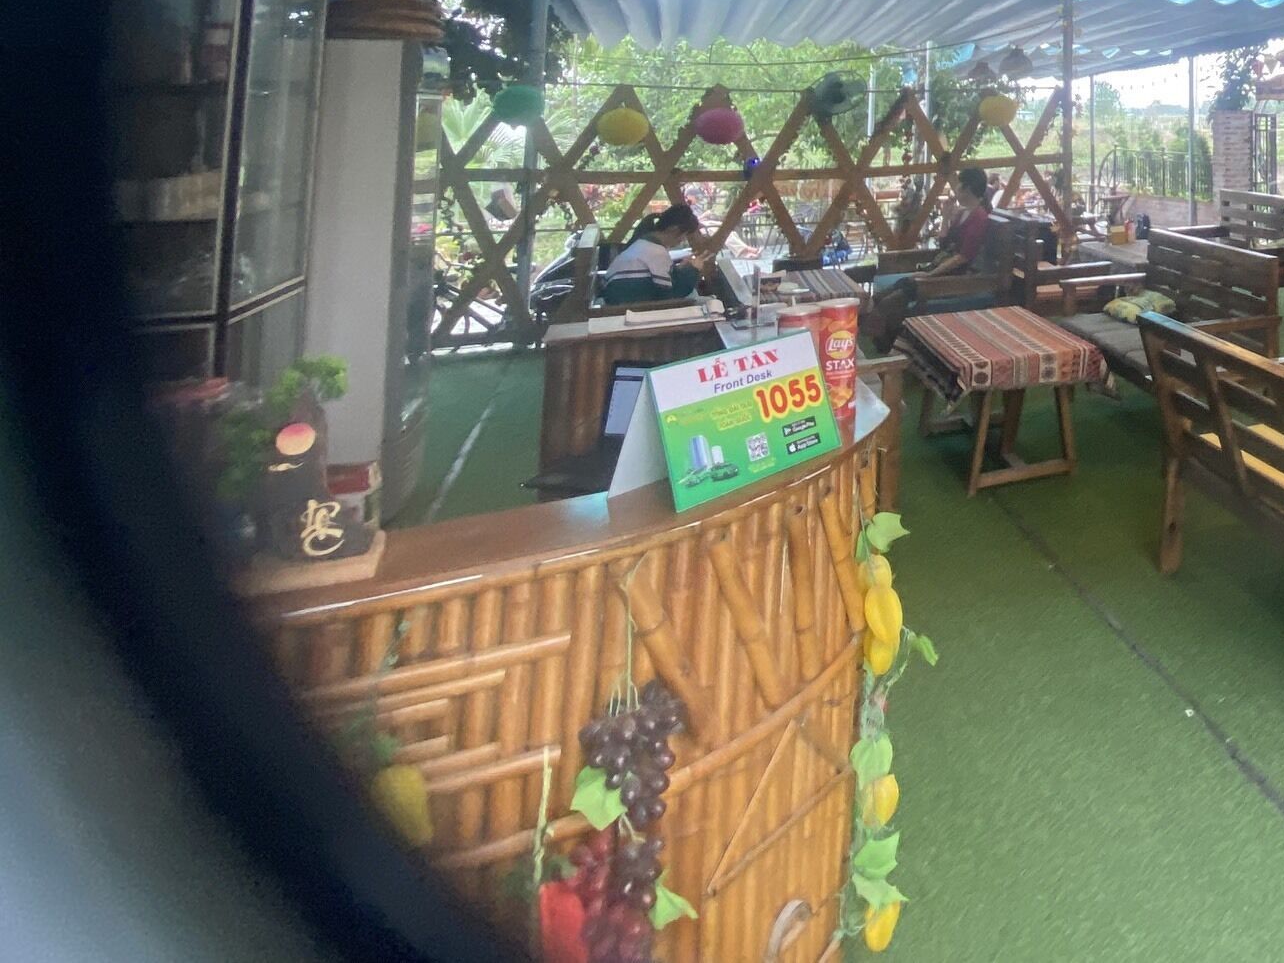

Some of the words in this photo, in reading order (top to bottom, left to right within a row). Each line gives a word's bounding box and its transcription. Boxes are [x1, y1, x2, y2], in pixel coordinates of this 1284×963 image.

[828, 337, 853, 352] Lay's
[697, 357, 729, 383] LỄ
[734, 349, 779, 373] TÂN
[825, 358, 855, 370] STAX
[714, 377, 743, 393] Front
[746, 370, 772, 386] Desk
[756, 374, 821, 418] 1055
